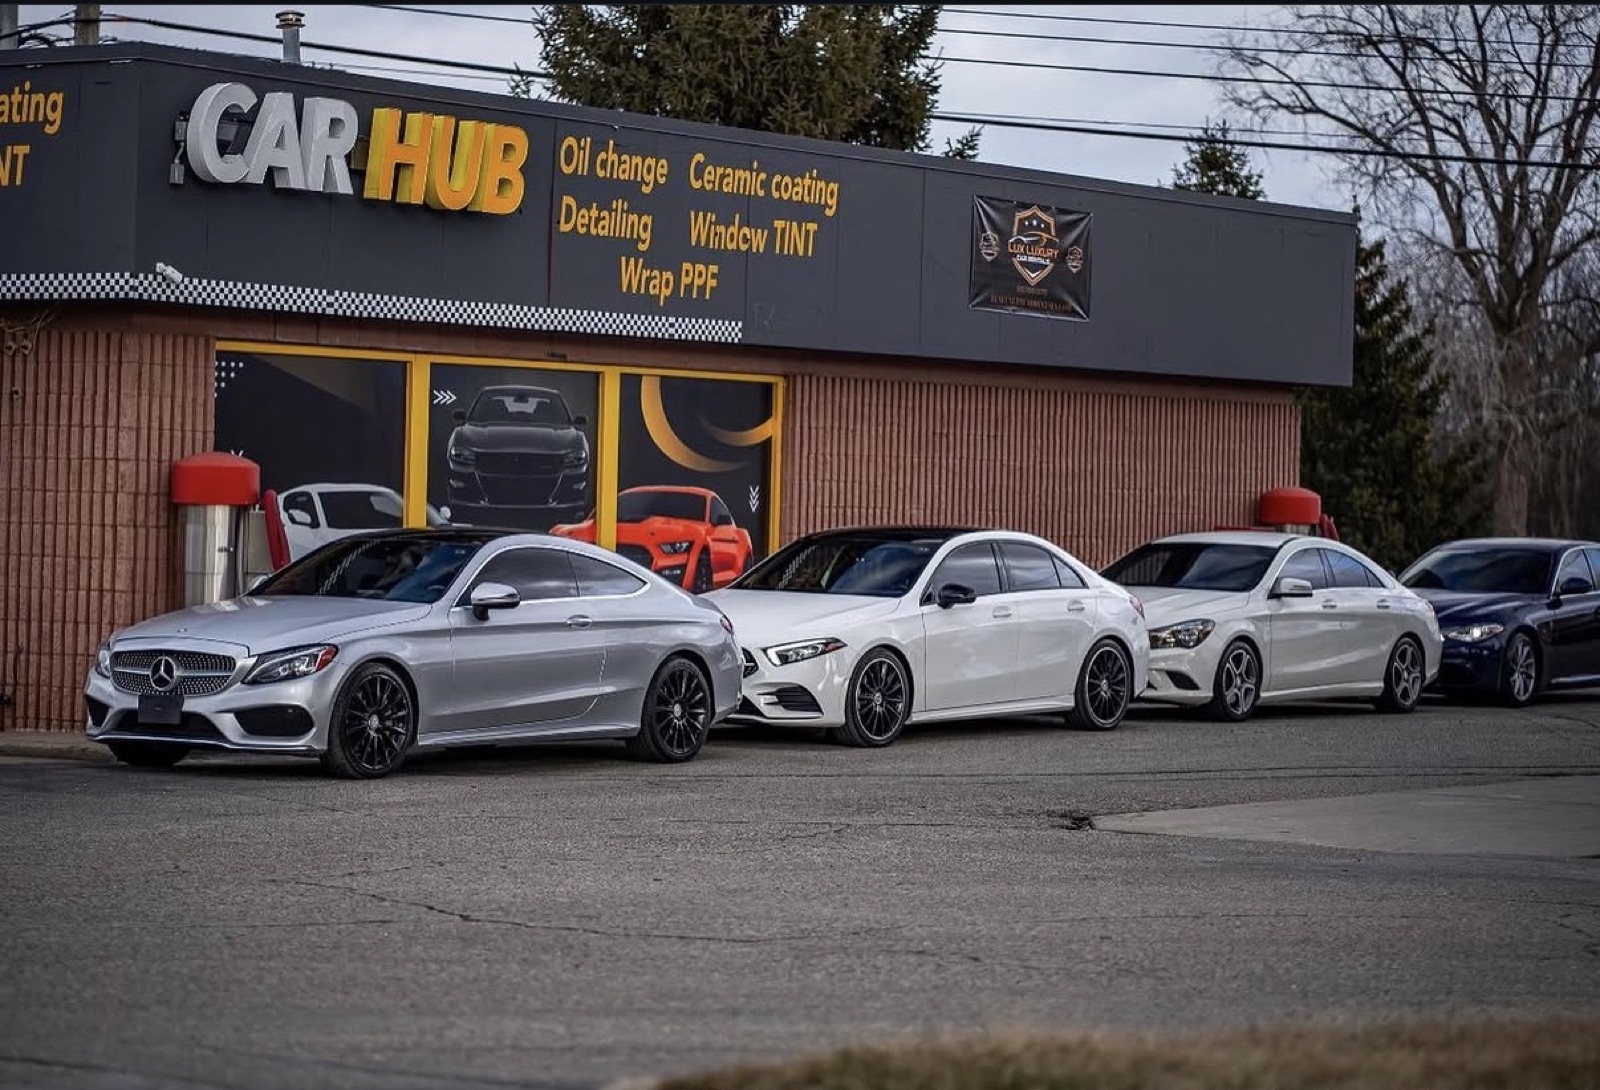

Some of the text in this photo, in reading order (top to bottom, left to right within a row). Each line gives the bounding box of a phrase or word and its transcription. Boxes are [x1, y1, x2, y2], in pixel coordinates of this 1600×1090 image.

[187, 82, 528, 214] CAR HUB
[559, 135, 669, 194] Oil change
[689, 153, 839, 217] Ceramic coating
[559, 195, 653, 251] Detailing
[689, 210, 818, 257] Window TINT
[620, 256, 719, 306] Wrap PPF
